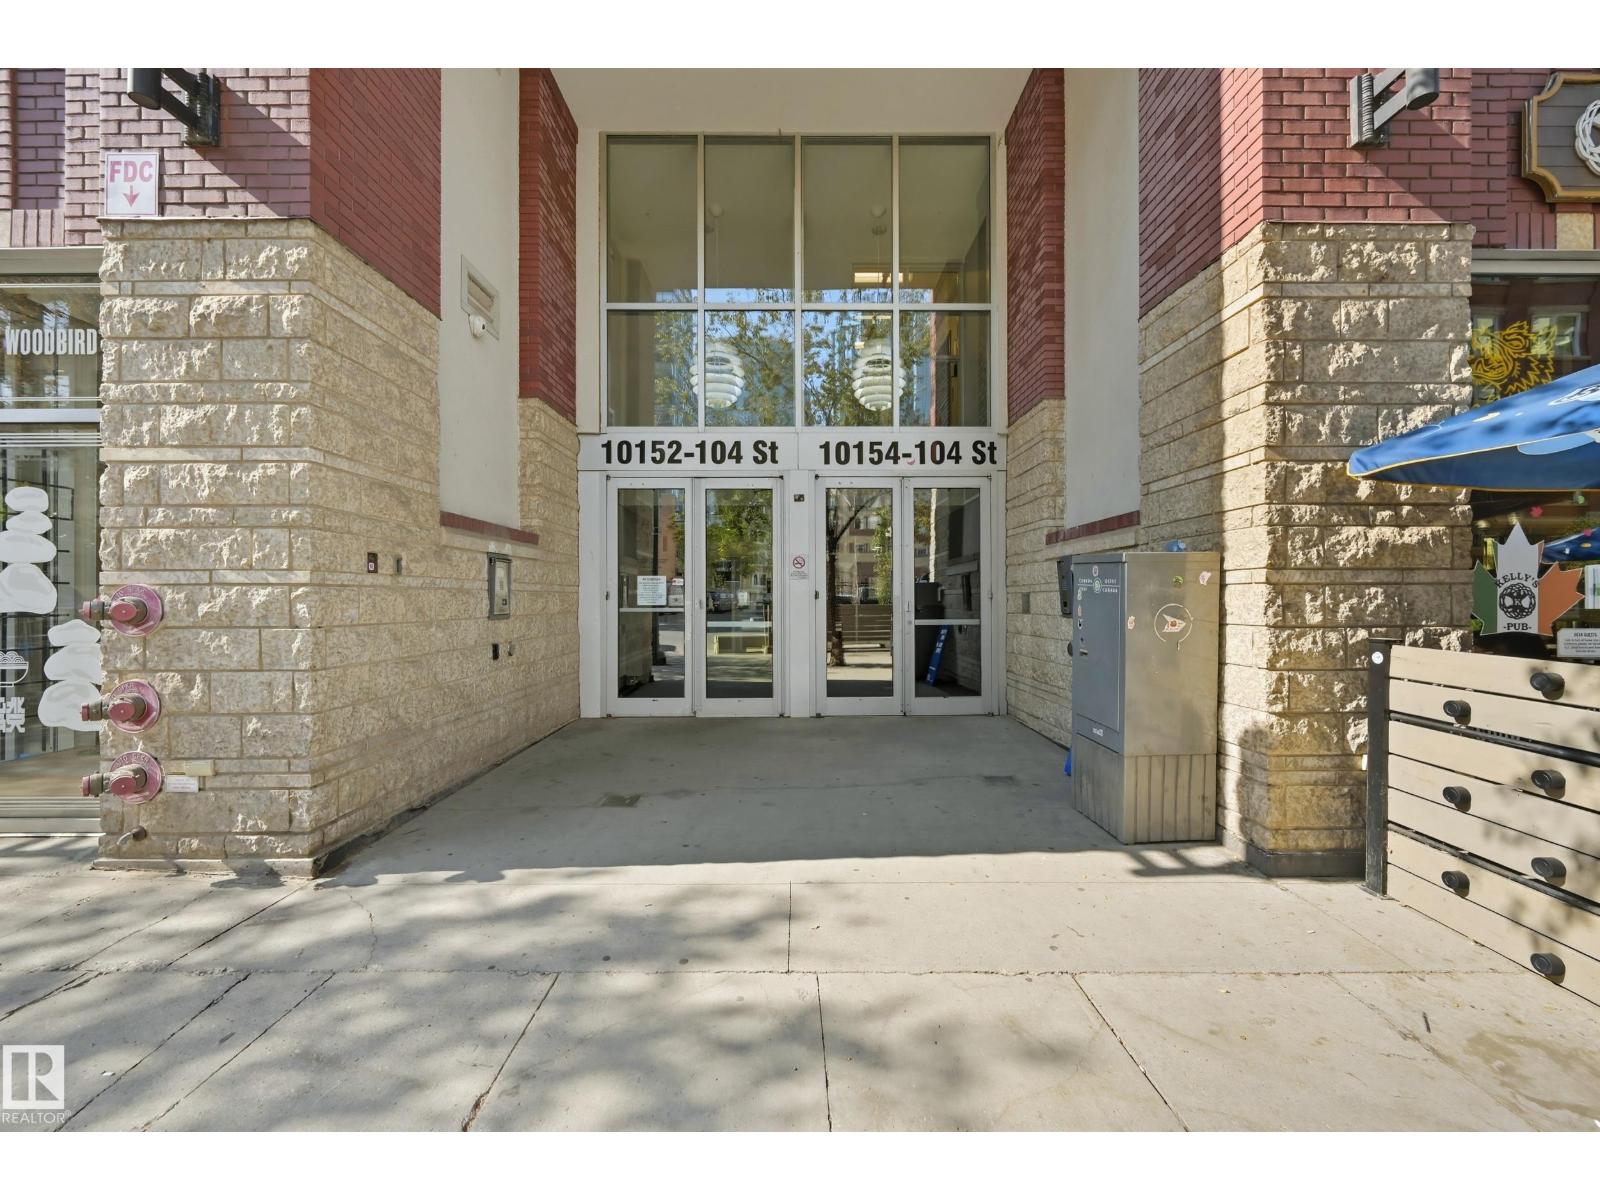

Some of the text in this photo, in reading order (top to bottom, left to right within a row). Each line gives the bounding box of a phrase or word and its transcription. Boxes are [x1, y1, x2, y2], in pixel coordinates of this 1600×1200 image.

[110, 160, 153, 183] FDC
[5, 327, 98, 355] WOODBIRD
[601, 439, 778, 465] 10152-104 St
[819, 439, 997, 465] 10154-104 St
[1495, 572, 1539, 588] KELLY'S
